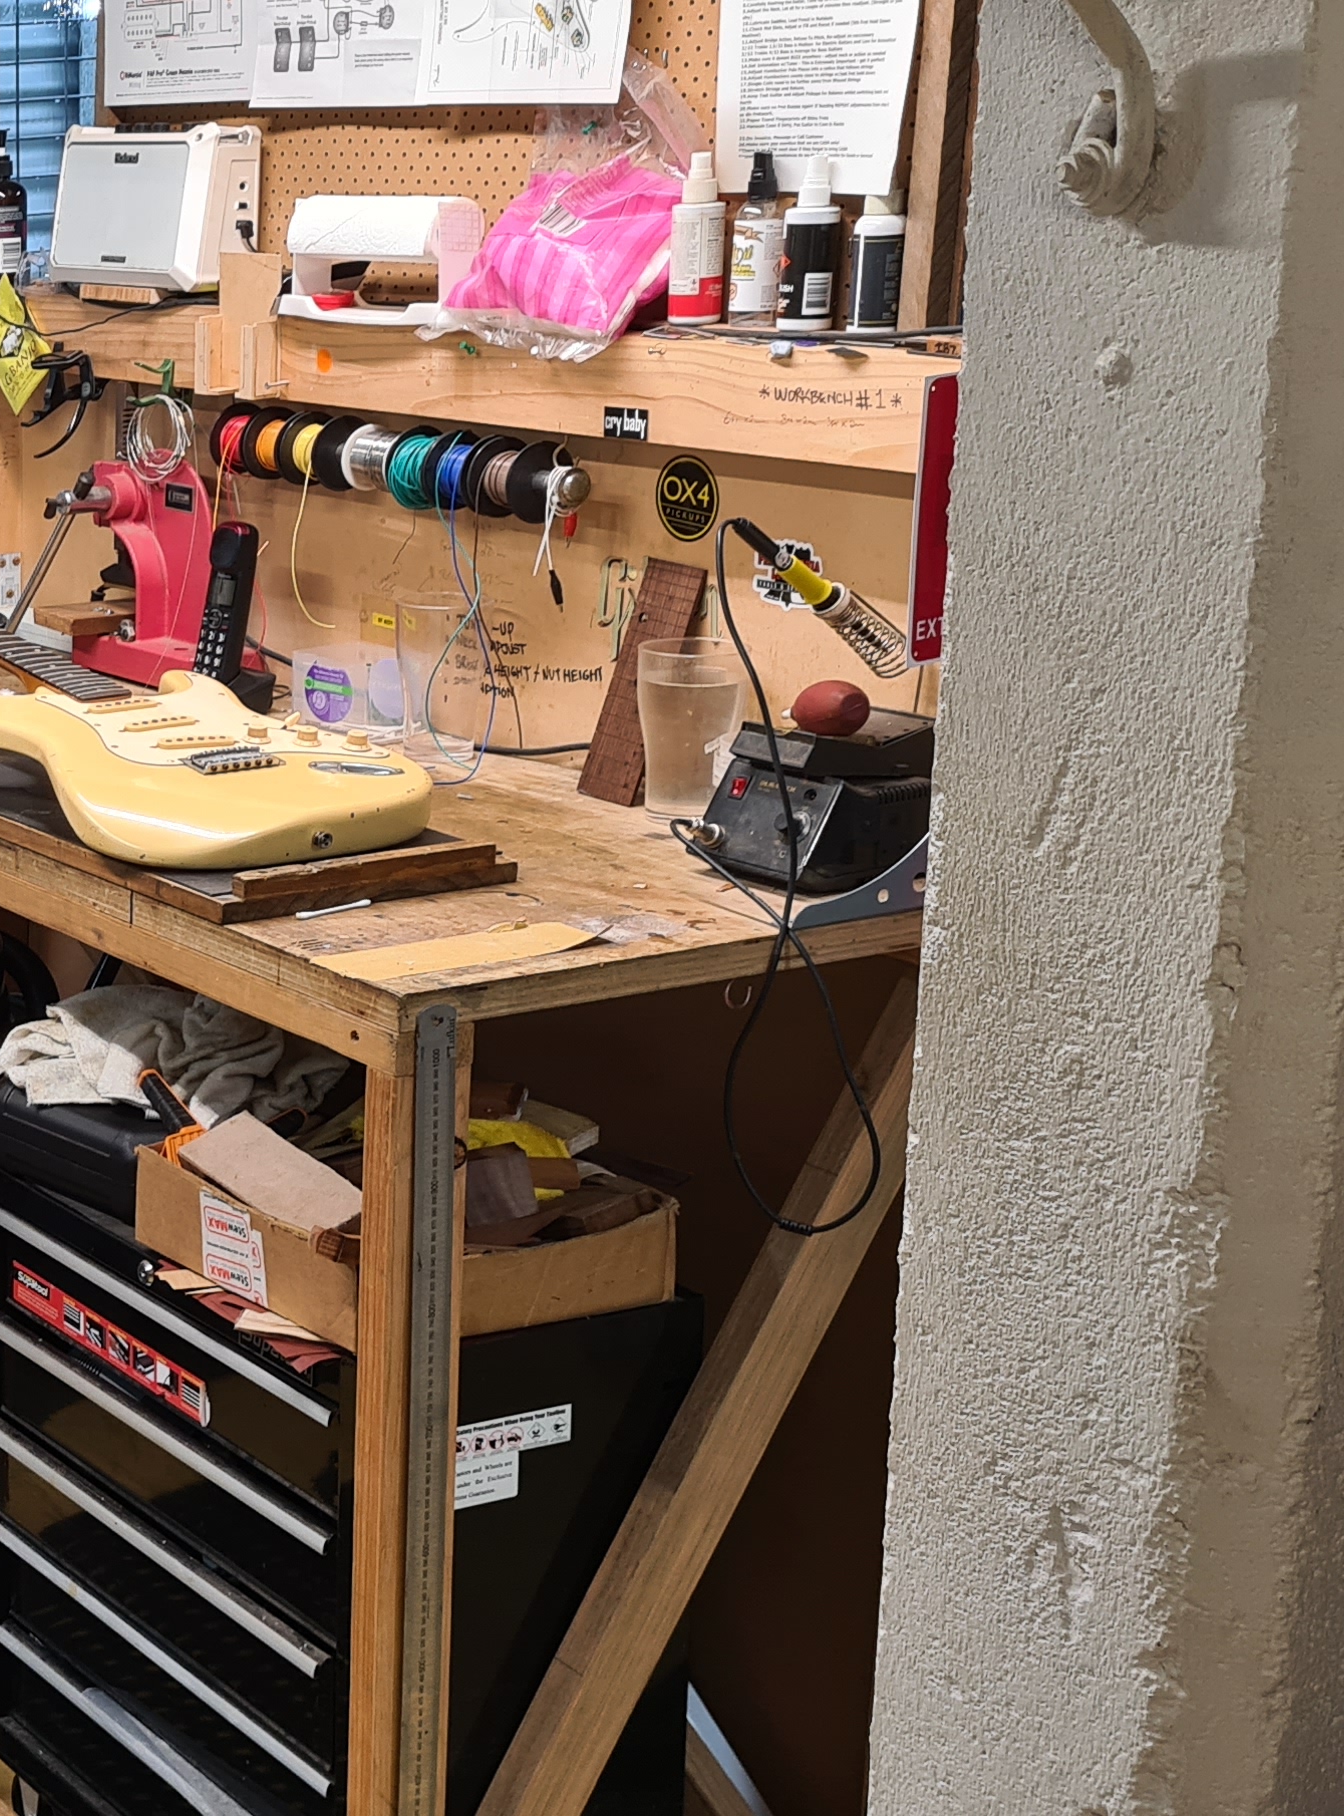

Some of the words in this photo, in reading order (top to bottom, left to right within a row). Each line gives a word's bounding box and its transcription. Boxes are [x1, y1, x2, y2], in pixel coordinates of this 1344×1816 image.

[115, 152, 139, 163] Roland
[773, 388, 853, 406] WORKBENCH
[605, 413, 623, 438] cry
[623, 407, 648, 439] baby
[662, 474, 711, 509] OX4
[665, 507, 706, 524] PICKUPS
[493, 667, 532, 683] HEIGHT
[541, 665, 562, 681] NUT
[563, 666, 603, 682] HEIGHT
[16, 1270, 50, 1298] Supatool
[473, 1422, 504, 1433] Precautions
